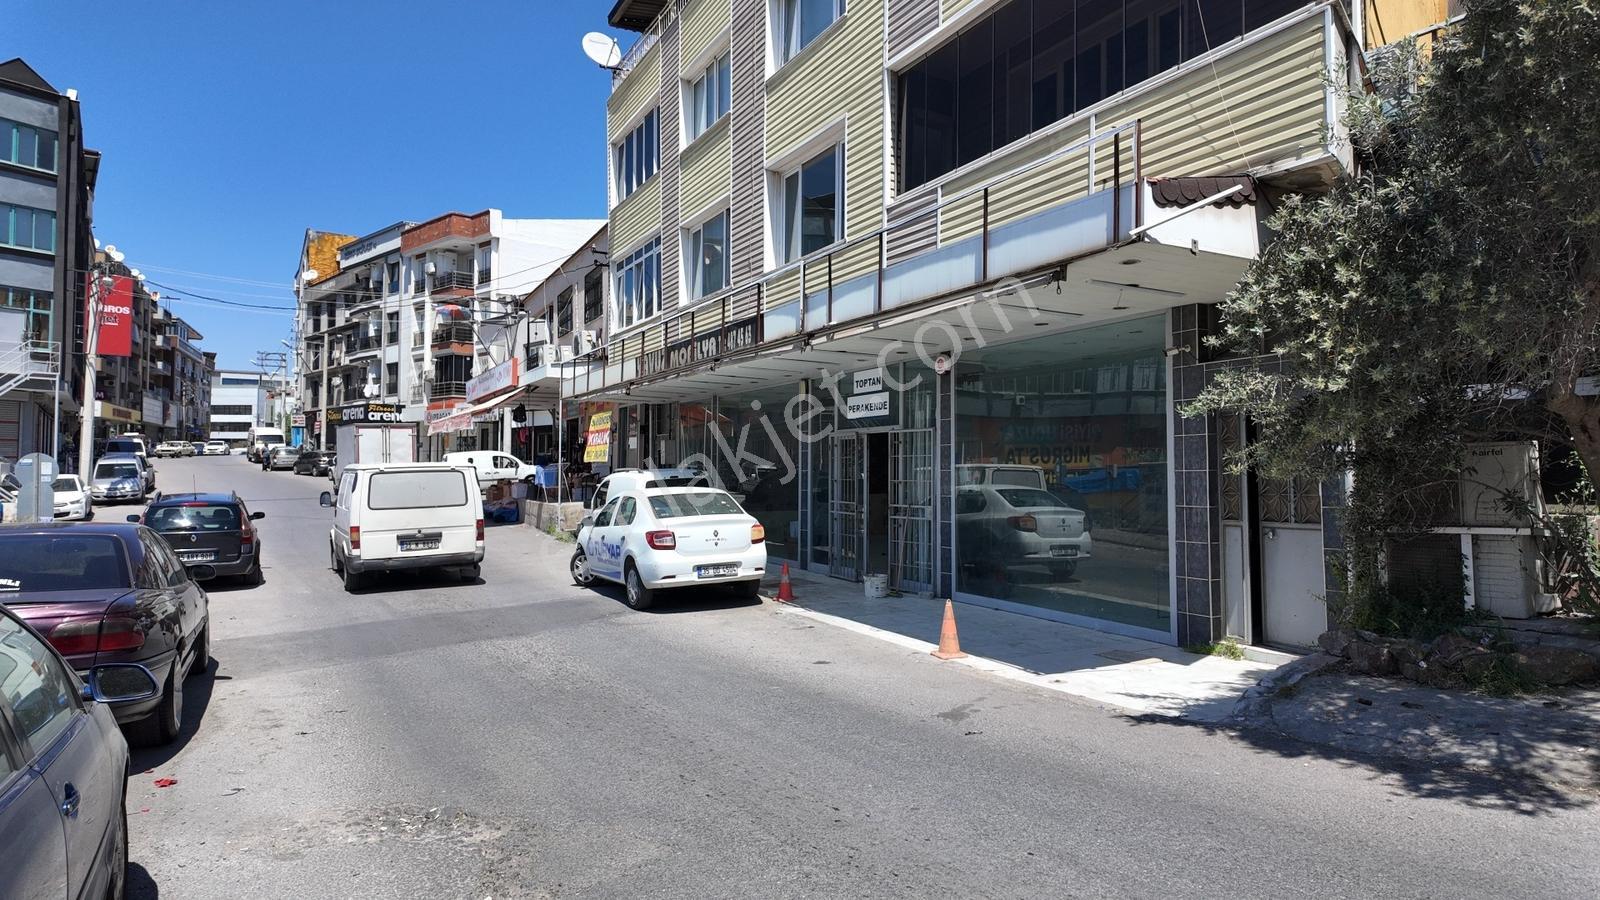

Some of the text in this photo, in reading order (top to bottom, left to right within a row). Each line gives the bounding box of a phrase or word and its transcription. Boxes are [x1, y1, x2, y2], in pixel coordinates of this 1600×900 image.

[855, 376, 881, 389] TOPTAN
[342, 407, 365, 420] arena
[848, 401, 888, 413] PERAKENDE
